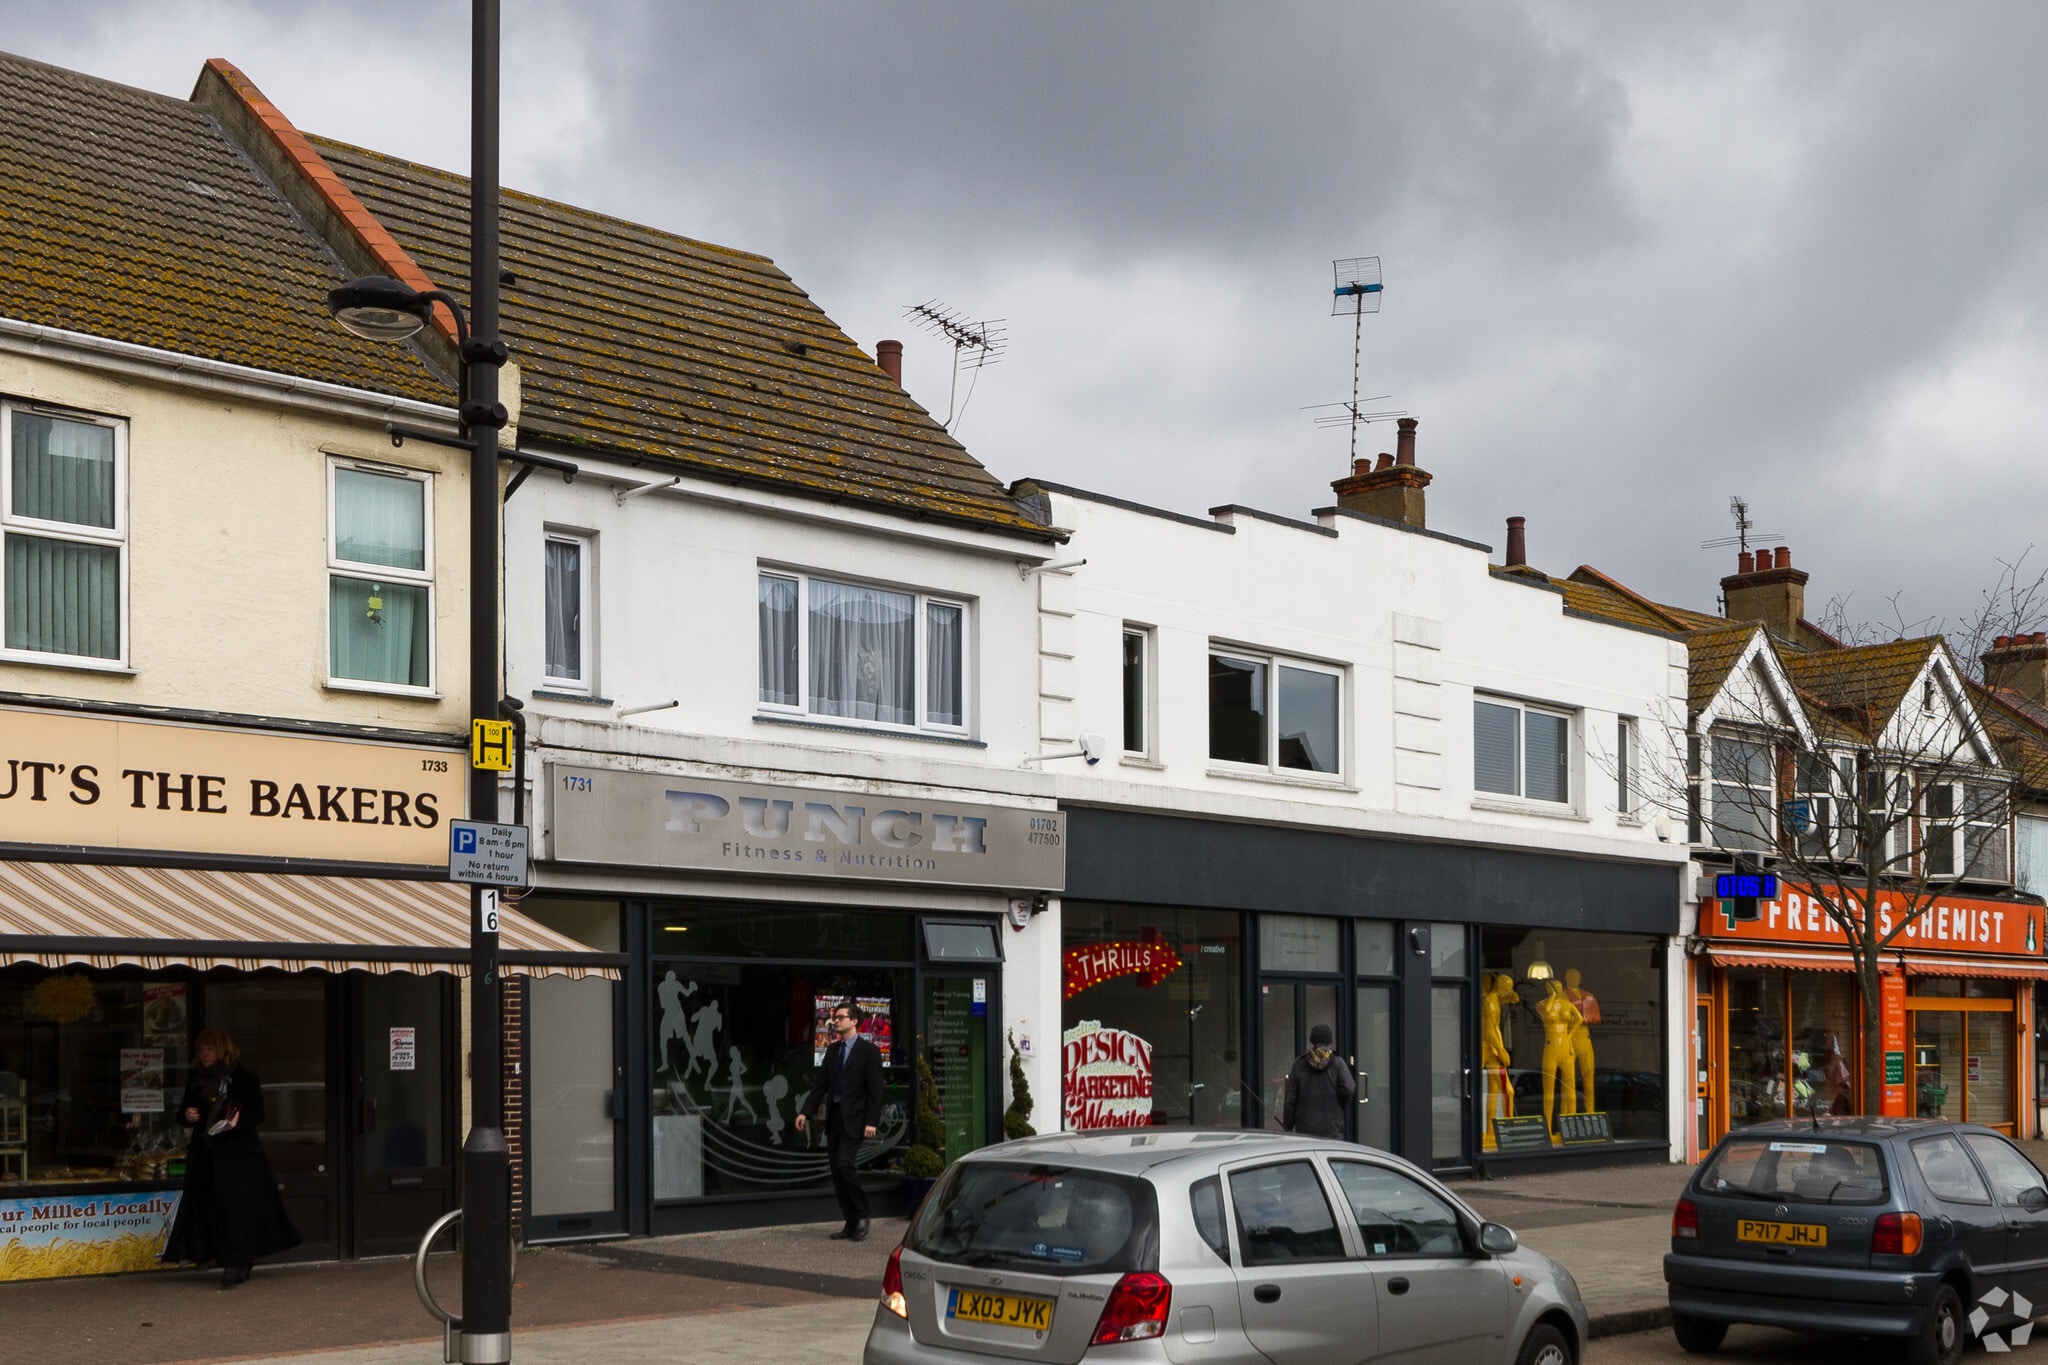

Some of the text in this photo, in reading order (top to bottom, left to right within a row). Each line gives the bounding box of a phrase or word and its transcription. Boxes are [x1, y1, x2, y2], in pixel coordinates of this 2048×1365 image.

[421, 760, 448, 773] 1733
[562, 776, 593, 793] 1731
[122, 769, 227, 814] THE
[250, 779, 439, 829] BAKERS
[665, 790, 987, 854] PUNCH
[1030, 817, 1057, 832] 01702
[491, 827, 513, 840] Daily
[1027, 831, 1060, 846] 477500
[511, 840, 525, 850] pm
[495, 849, 514, 860] hour
[722, 842, 936, 870] Fitness & Nutrition
[469, 860, 510, 872] No return
[458, 869, 485, 879] within
[495, 872, 519, 882] hours
[1078, 948, 1151, 981] THRILLS
[1064, 1031, 1152, 1077] DESIGN
[1064, 1068, 1152, 1099] MARKETING
[32, 1203, 96, 1220] Milled
[103, 1199, 173, 1216] Locally
[20, 1221, 60, 1235] people
[63, 1220, 79, 1229] for
[83, 1218, 109, 1229] local
[113, 1216, 151, 1229] people
[1785, 1227, 1820, 1242] JHJ
[957, 1292, 1048, 1326] LX03 JYK
